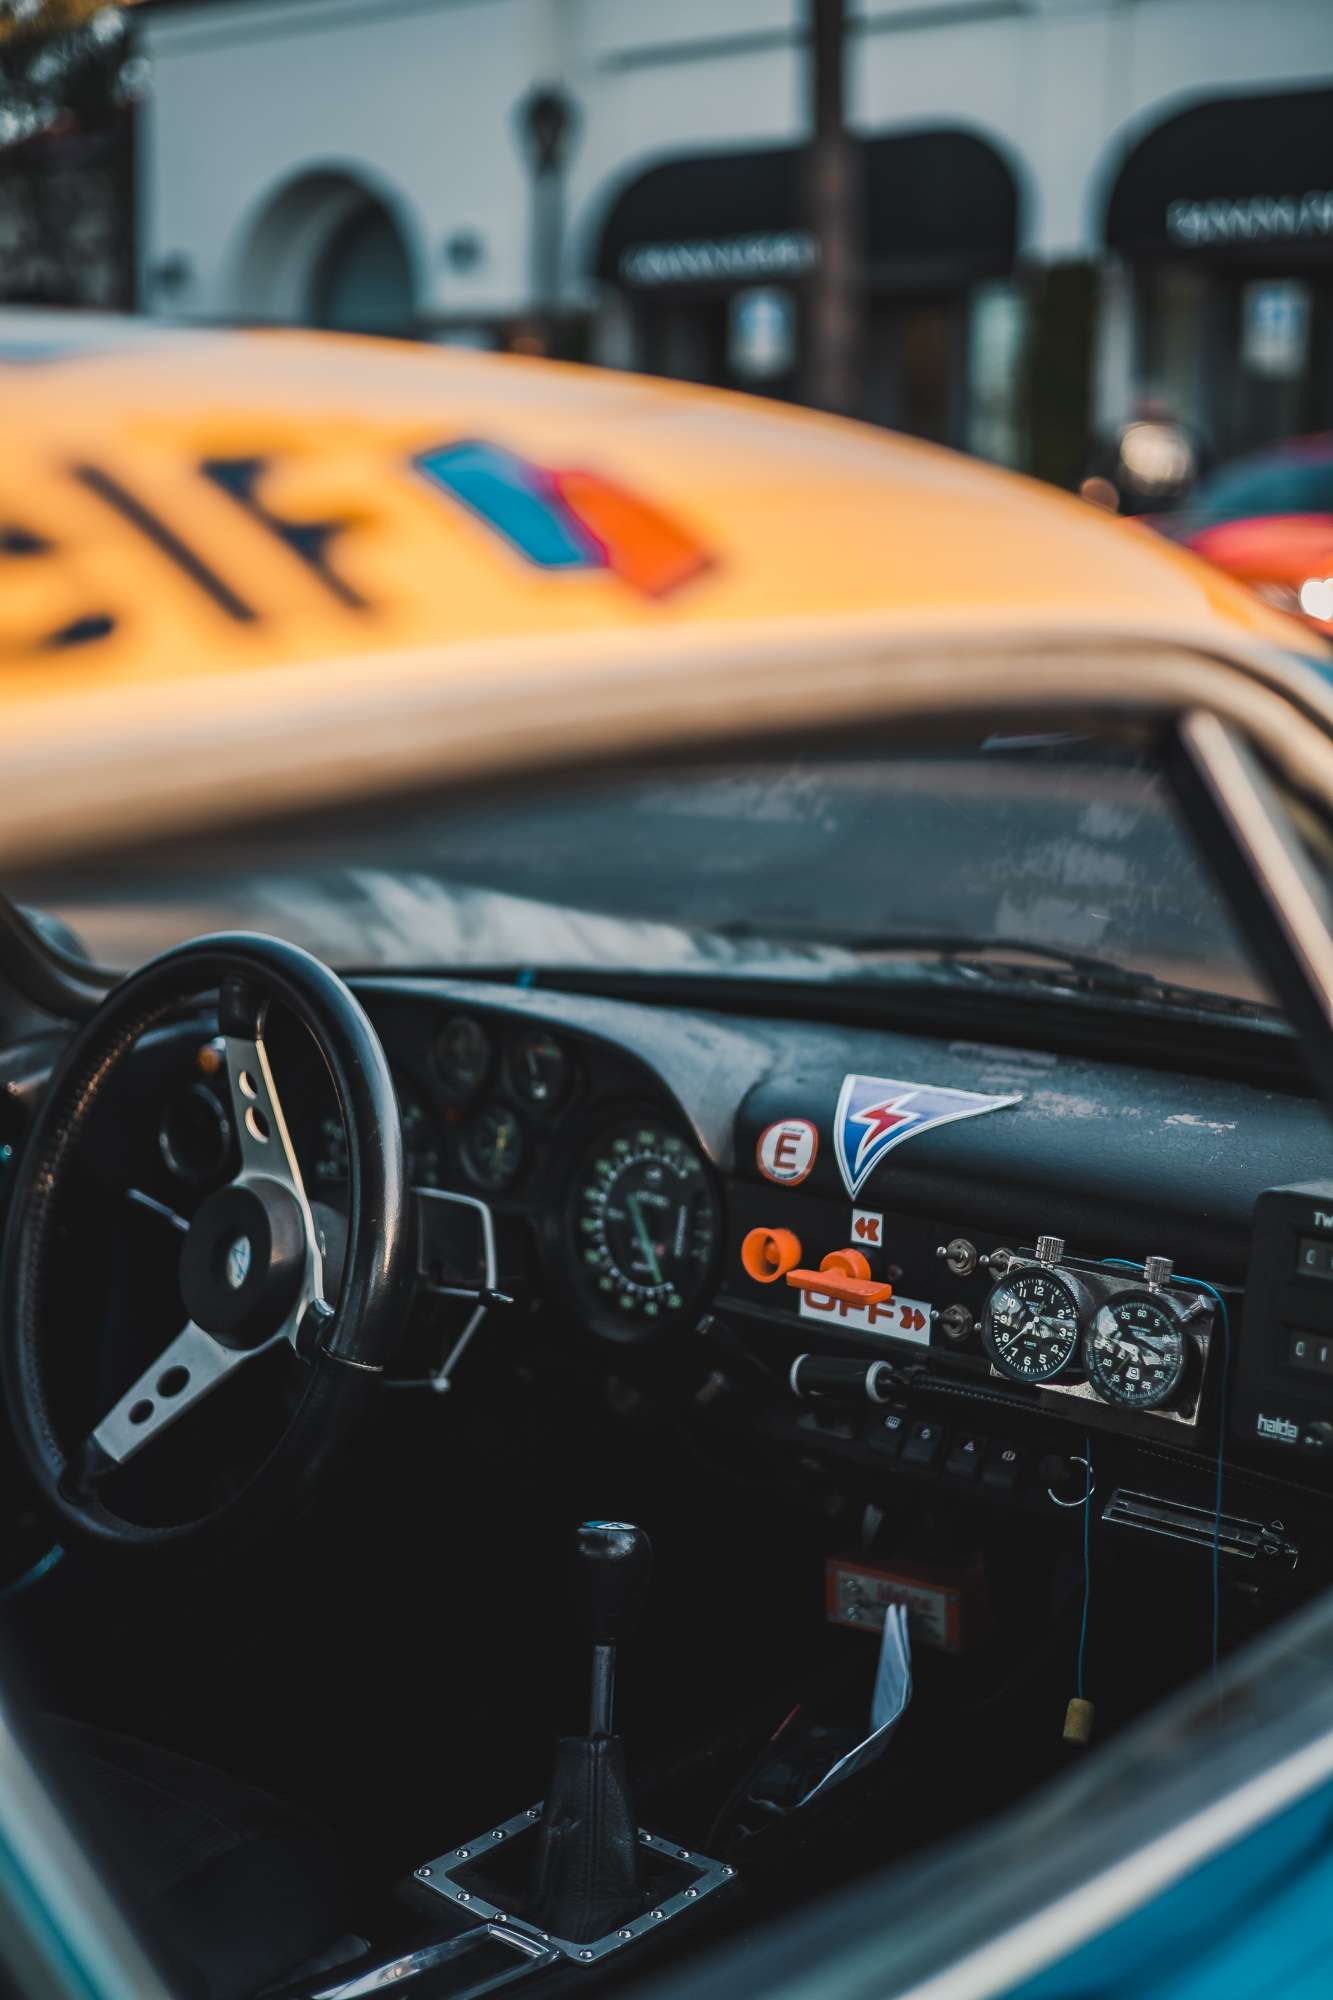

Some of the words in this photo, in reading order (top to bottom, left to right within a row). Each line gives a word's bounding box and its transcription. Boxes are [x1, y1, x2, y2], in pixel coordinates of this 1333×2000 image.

[773, 1133, 801, 1170] E
[1019, 1287, 1027, 1298] 11
[1034, 1285, 1044, 1296] 12
[1007, 1298, 1016, 1308] 10
[1050, 1294, 1055, 1304] 1
[1057, 1309, 1065, 1319] 2
[1120, 1311, 1131, 1320] 55
[1137, 1309, 1147, 1318] 60
[999, 1314, 1008, 1324] 9
[1154, 1319, 1160, 1327] 5
[1059, 1327, 1067, 1337] 3
[1001, 1332, 1010, 1343] 8
[1010, 1347, 1019, 1357] 7
[1050, 1344, 1059, 1354] 4
[1023, 1356, 1032, 1366] 6
[1039, 1354, 1047, 1364] 5
[1102, 1358, 1112, 1367] 40
[1163, 1353, 1172, 1362] 15
[1130, 1367, 1138, 1379] 9
[1154, 1370, 1164, 1379] 20
[1110, 1374, 1120, 1383] 35
[1125, 1382, 1135, 1392] 30
[1141, 1381, 1152, 1390] 25
[1257, 1413, 1299, 1438] halda
